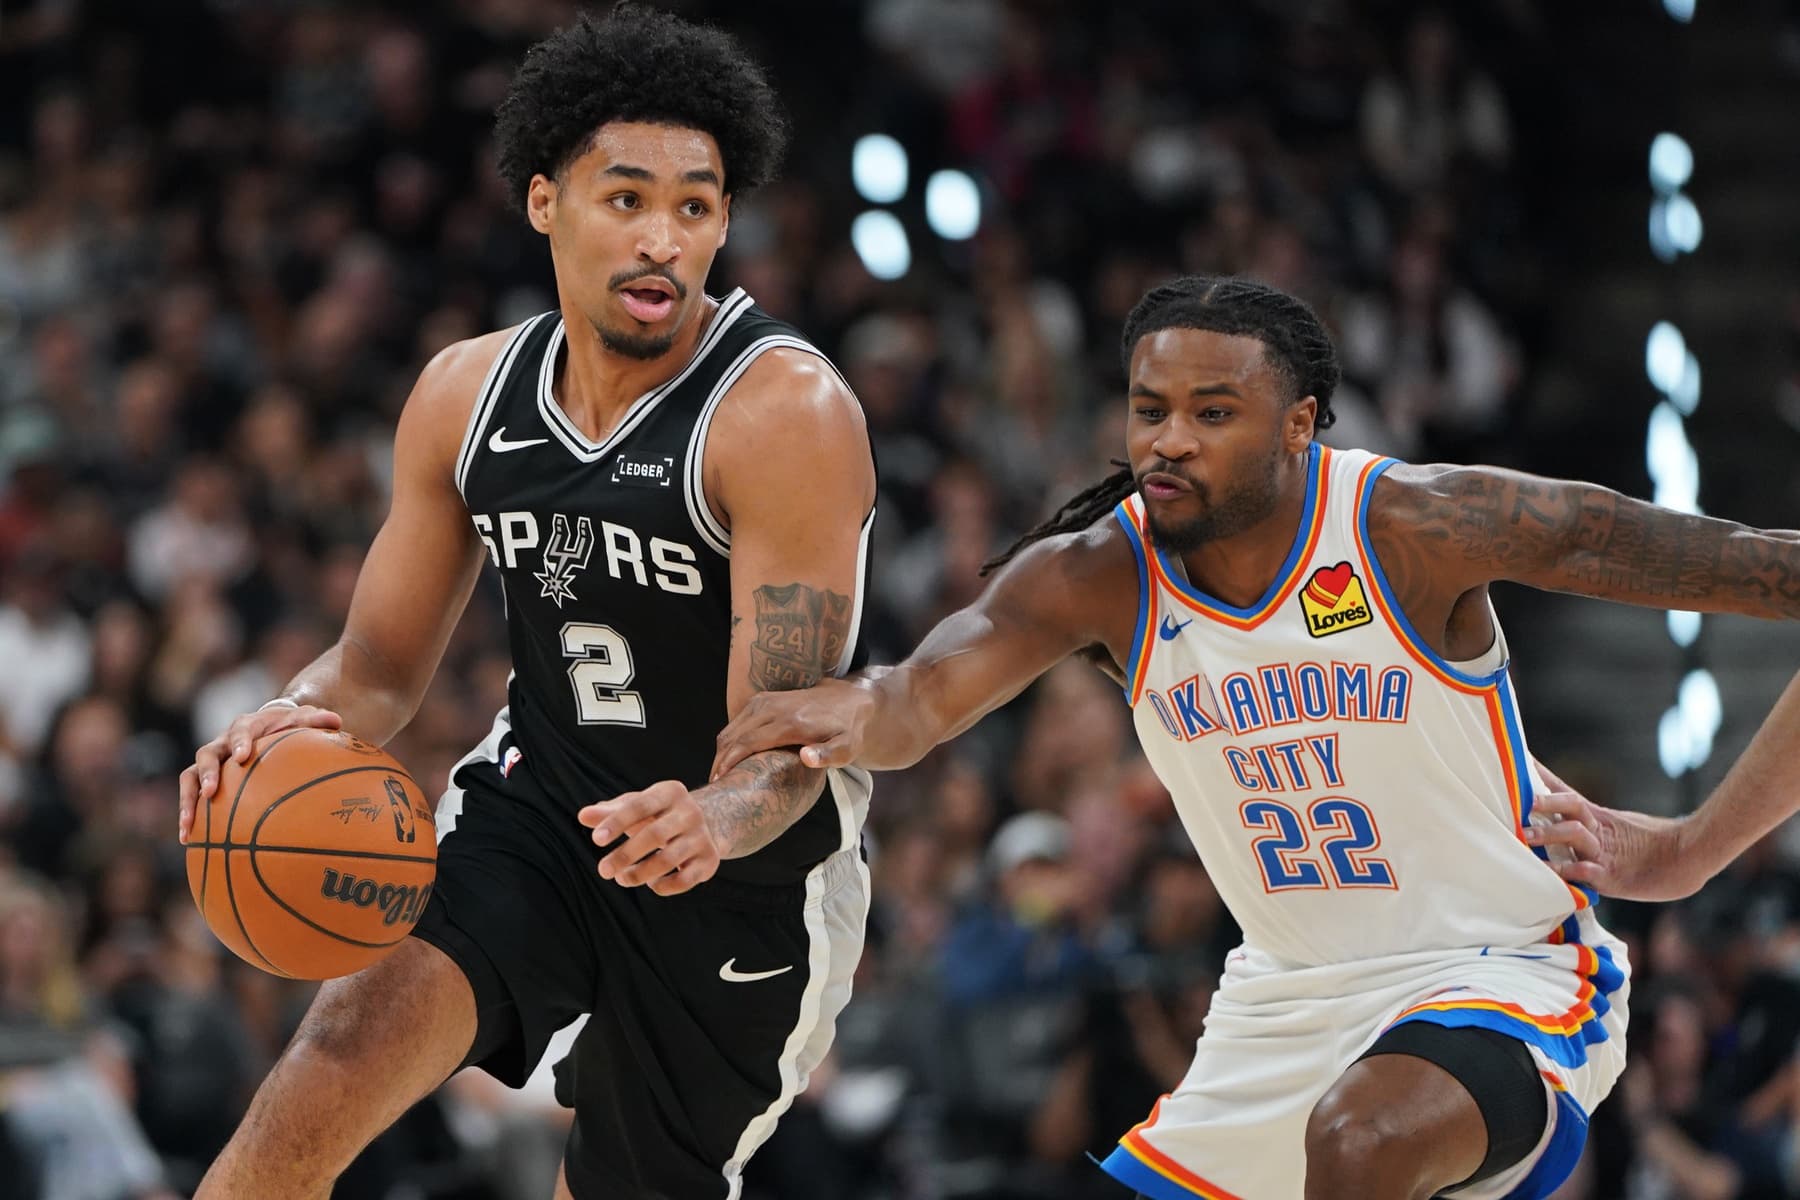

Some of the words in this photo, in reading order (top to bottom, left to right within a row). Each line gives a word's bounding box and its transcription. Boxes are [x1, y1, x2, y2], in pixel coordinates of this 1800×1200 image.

[619, 462, 664, 478] LEDGER
[766, 623, 805, 657] 24
[558, 620, 647, 728] 2
[1222, 732, 1345, 793] CITY
[1238, 796, 1400, 894] 22
